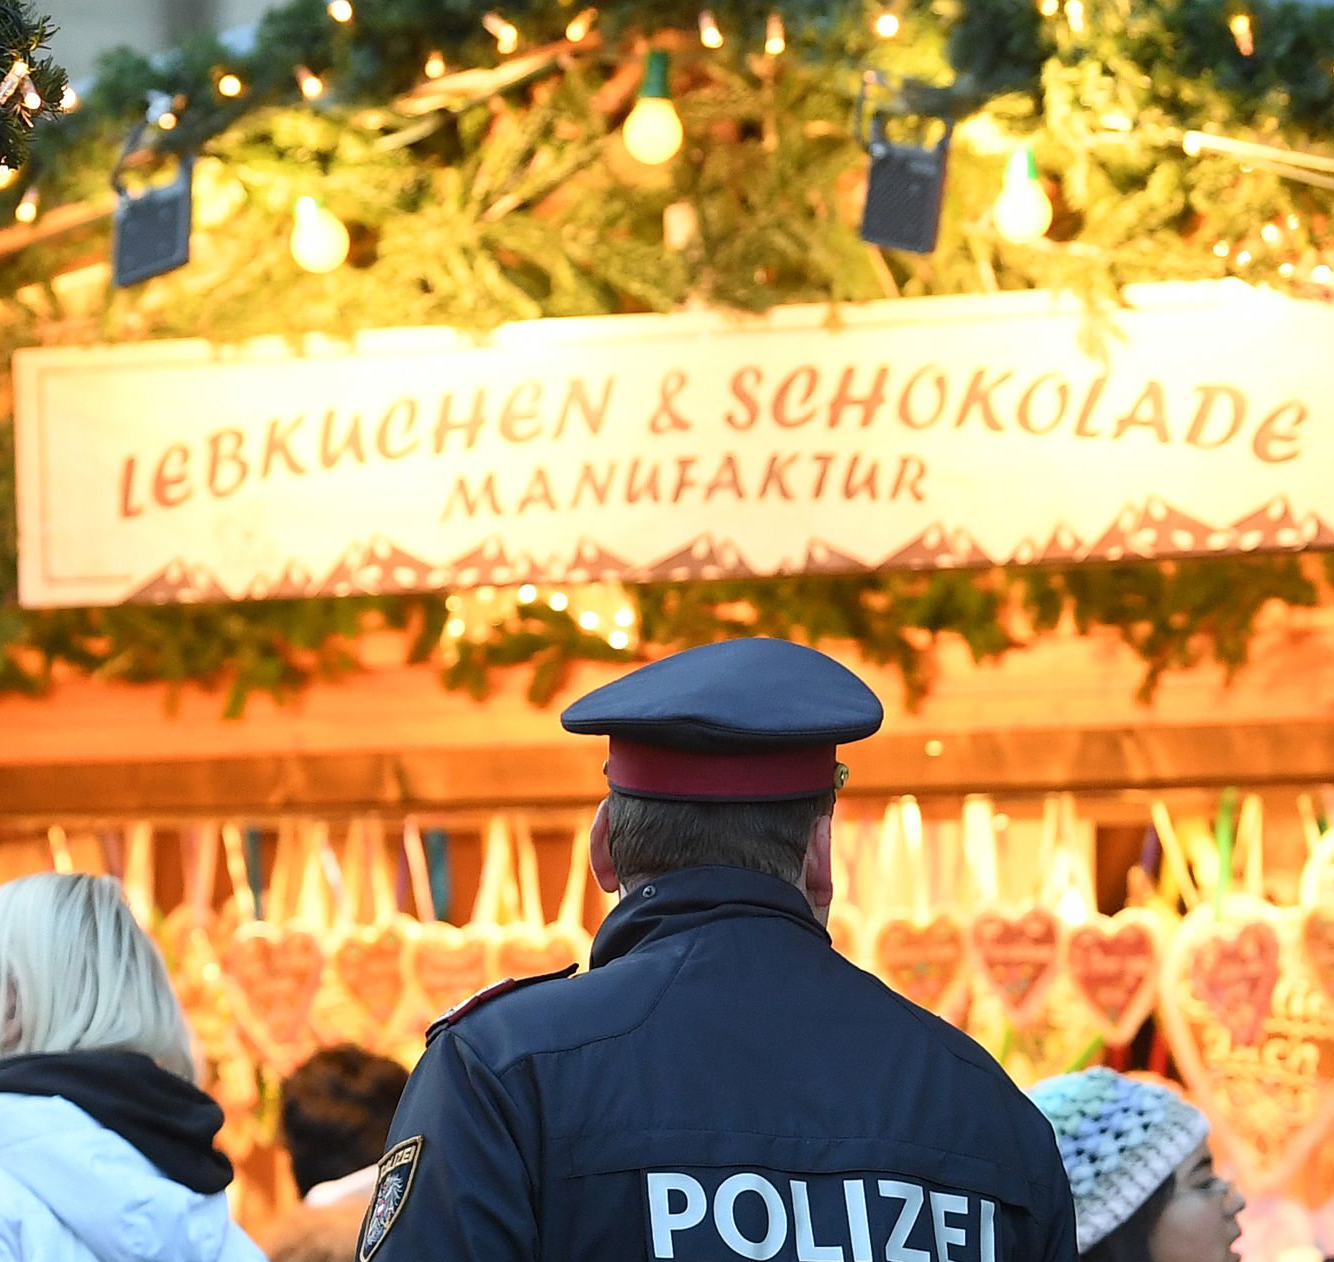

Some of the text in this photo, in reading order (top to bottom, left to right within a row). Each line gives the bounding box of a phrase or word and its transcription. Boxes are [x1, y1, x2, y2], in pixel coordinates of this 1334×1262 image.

[120, 363, 1311, 519] LEBKUCHEN & SCHOKOLADE
[440, 450, 930, 522] MANUFAKTUR
[380, 1145, 416, 1179] OLIZEI
